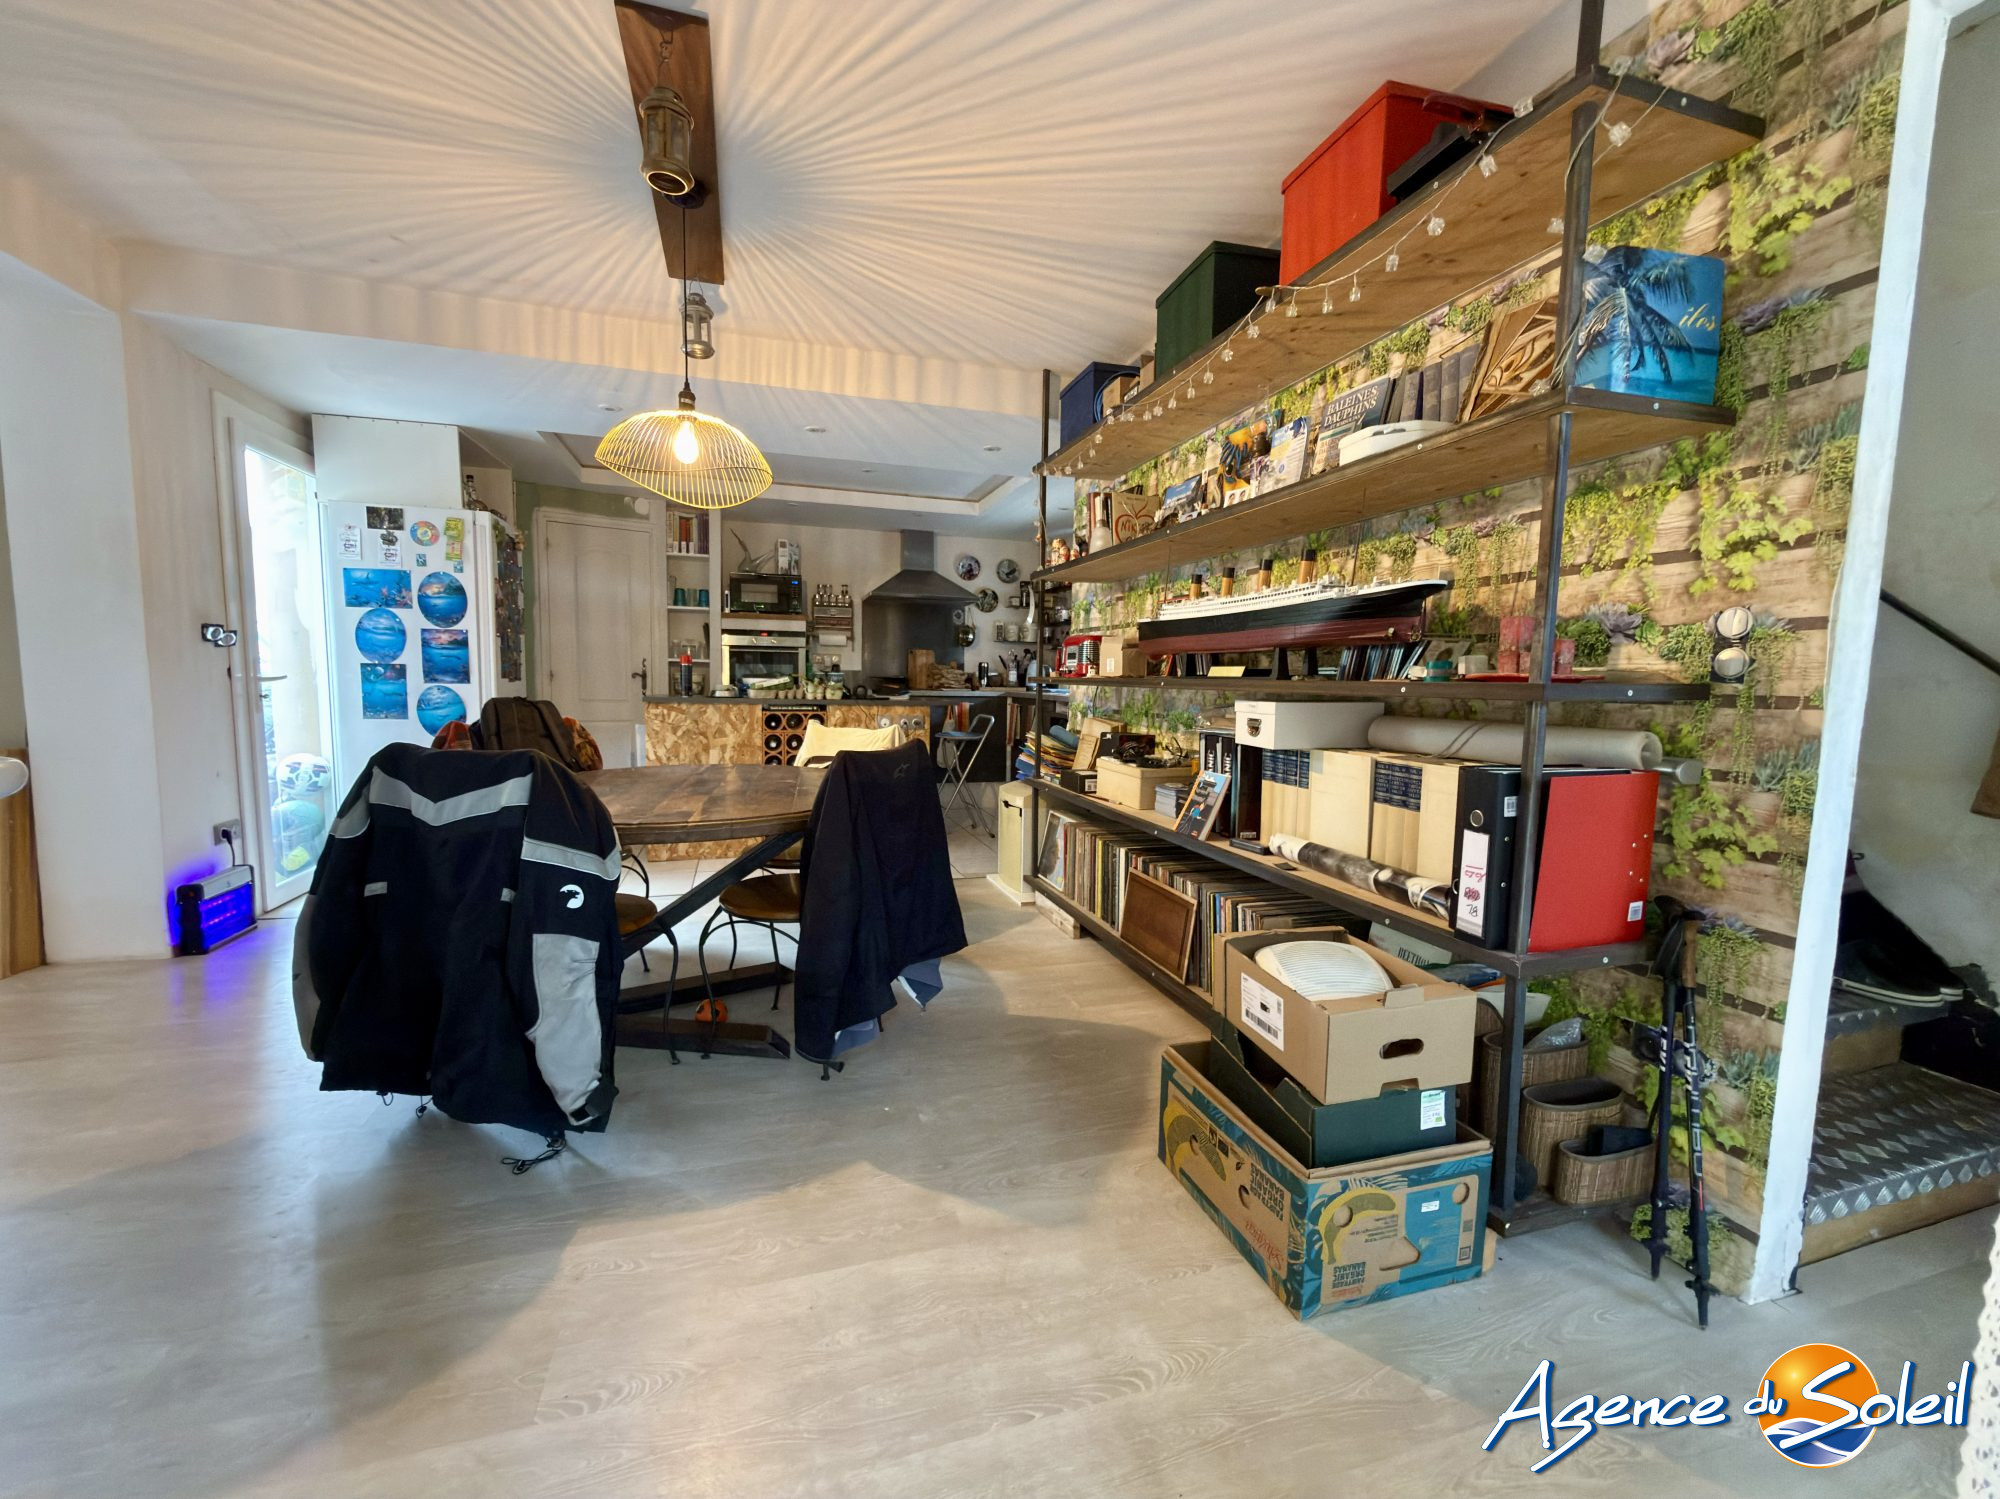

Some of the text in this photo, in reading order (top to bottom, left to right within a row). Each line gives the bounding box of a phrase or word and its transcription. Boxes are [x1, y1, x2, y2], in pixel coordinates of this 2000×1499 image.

[1324, 397, 1377, 427] DAUPHINS
[1328, 386, 1378, 415] BALEINES
[1250, 1162, 1284, 1201] BANANAS
[1250, 1174, 1283, 1212] ORGANIC
